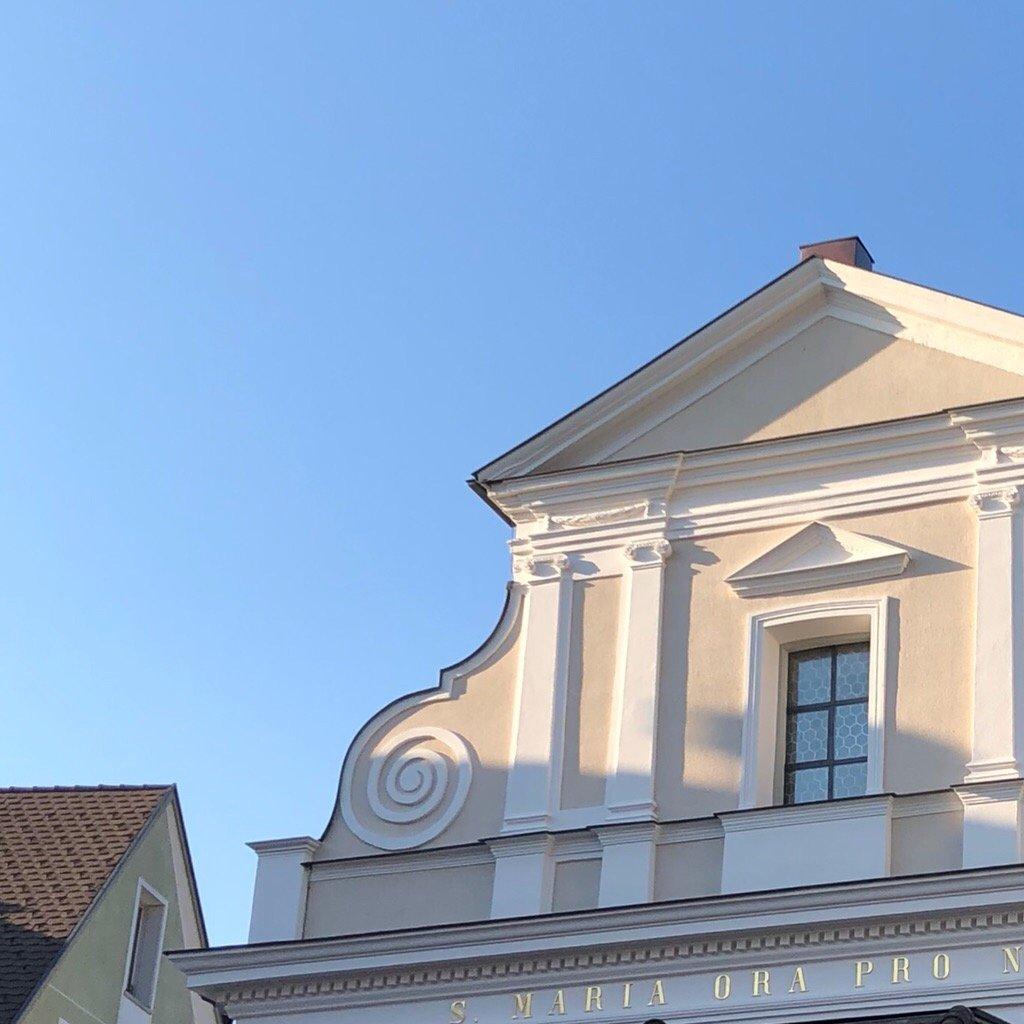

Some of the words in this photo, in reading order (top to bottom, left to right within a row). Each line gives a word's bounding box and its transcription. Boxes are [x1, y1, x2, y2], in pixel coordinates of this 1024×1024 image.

[450, 1001, 479, 1024] S.
[513, 979, 667, 1019] MARIA
[714, 966, 807, 999] ORA
[854, 953, 950, 988] PRO
